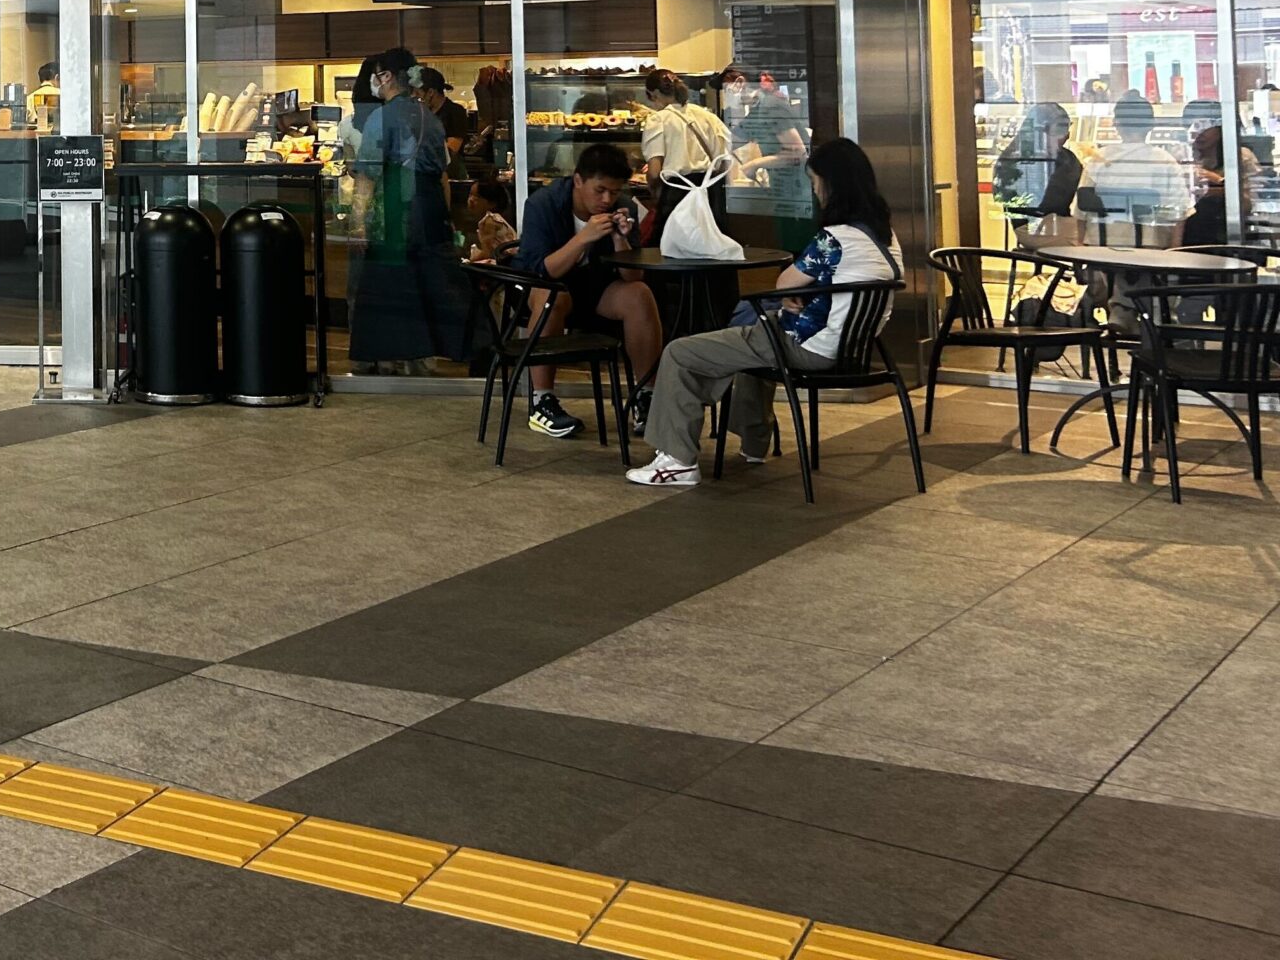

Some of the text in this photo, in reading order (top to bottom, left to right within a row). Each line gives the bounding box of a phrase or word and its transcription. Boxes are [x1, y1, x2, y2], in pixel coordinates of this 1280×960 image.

[1139, 5, 1180, 23] est
[46, 158, 64, 167] 7:00
[74, 158, 96, 167] 23:00
